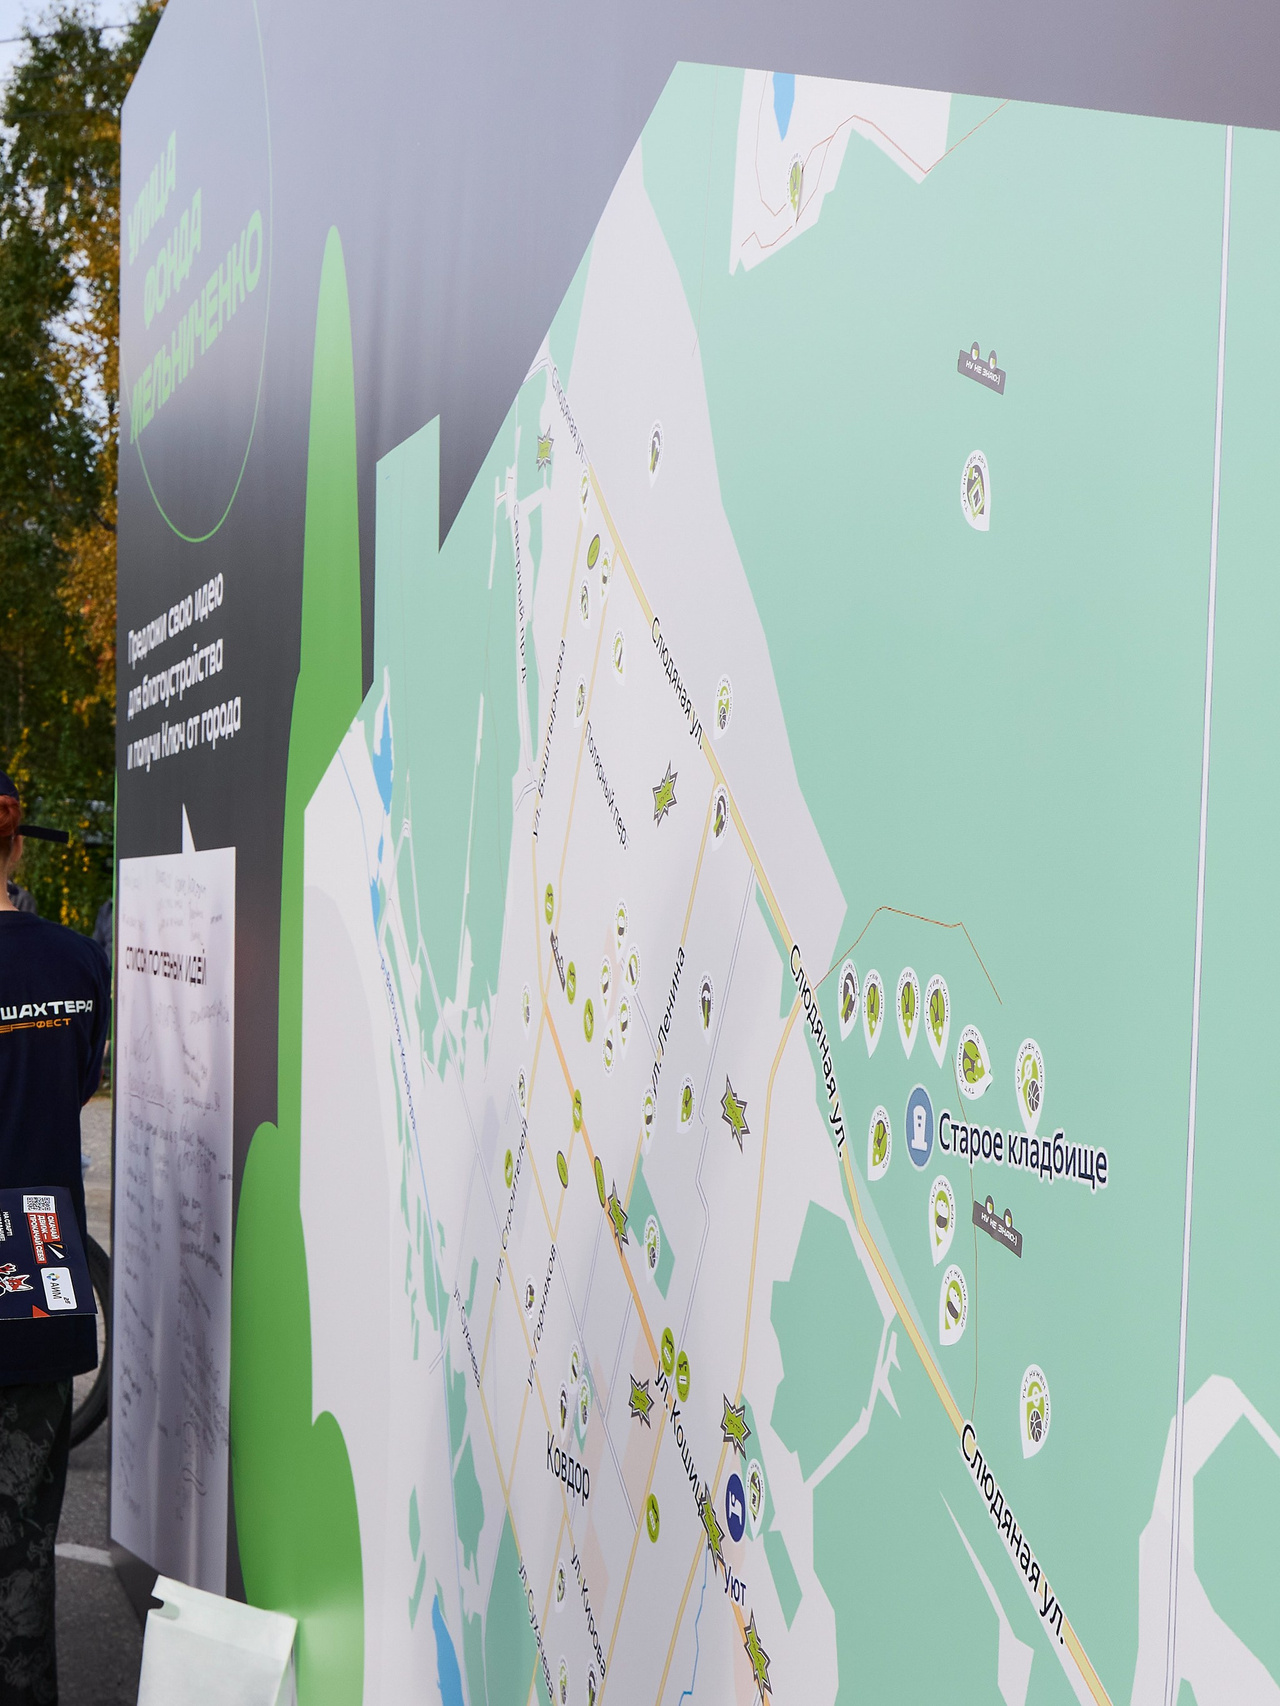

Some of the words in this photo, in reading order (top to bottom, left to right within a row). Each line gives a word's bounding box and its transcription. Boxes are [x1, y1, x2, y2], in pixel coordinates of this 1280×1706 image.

[127, 129, 176, 267] УЛИЦА
[144, 187, 202, 331] ФОНДА
[130, 209, 263, 444] МЕЛЬНИЧЕНКО
[966, 360, 974, 370] НУ
[974, 364, 982, 374] НЕ
[127, 613, 167, 669] Предложи
[168, 594, 193, 638] свою
[194, 571, 224, 622] идею
[127, 684, 141, 721] для
[142, 638, 224, 708] благоустройства
[538, 639, 566, 799] Баштыркова
[651, 617, 692, 721] Слюдяная
[689, 712, 703, 750] ул.
[133, 732, 160, 773] получи
[161, 720, 185, 758] Ключ
[187, 714, 200, 749] от
[201, 696, 241, 750] города
[584, 720, 615, 812] Полярный
[612, 807, 629, 850] пер.
[0, 1000, 93, 1021] ШАХТЕРА
[651, 1060, 662, 1100] ул.
[658, 946, 686, 1056] Ленина
[790, 945, 837, 1100] Слюдяная
[829, 1101, 846, 1158] ул.
[502, 1120, 528, 1250] Строителей
[939, 1112, 1004, 1165] Старое
[1008, 1132, 1108, 1190] кладбище
[29, 1214, 43, 1246] ПРОКАЧАЙ
[35, 1245, 45, 1262] СЕБЯ
[37, 1215, 48, 1233] ДВИЖ
[47, 1215, 60, 1240] СКАЧАЙ
[981, 1212, 990, 1223] НУ
[990, 1218, 998, 1230] НЕ
[50, 1282, 62, 1300] АИМ
[533, 1244, 557, 1352] Горняков
[546, 1430, 591, 1507] Ковдор
[655, 1360, 669, 1409] ул.
[670, 1399, 705, 1517] Кошиц
[518, 1556, 528, 1596] ул.
[962, 1424, 1041, 1592] Слюдяная
[1039, 1582, 1064, 1645] ул.
[571, 1544, 582, 1586] ул.
[581, 1578, 606, 1680] Кирова
[724, 1566, 747, 1606] Уют
